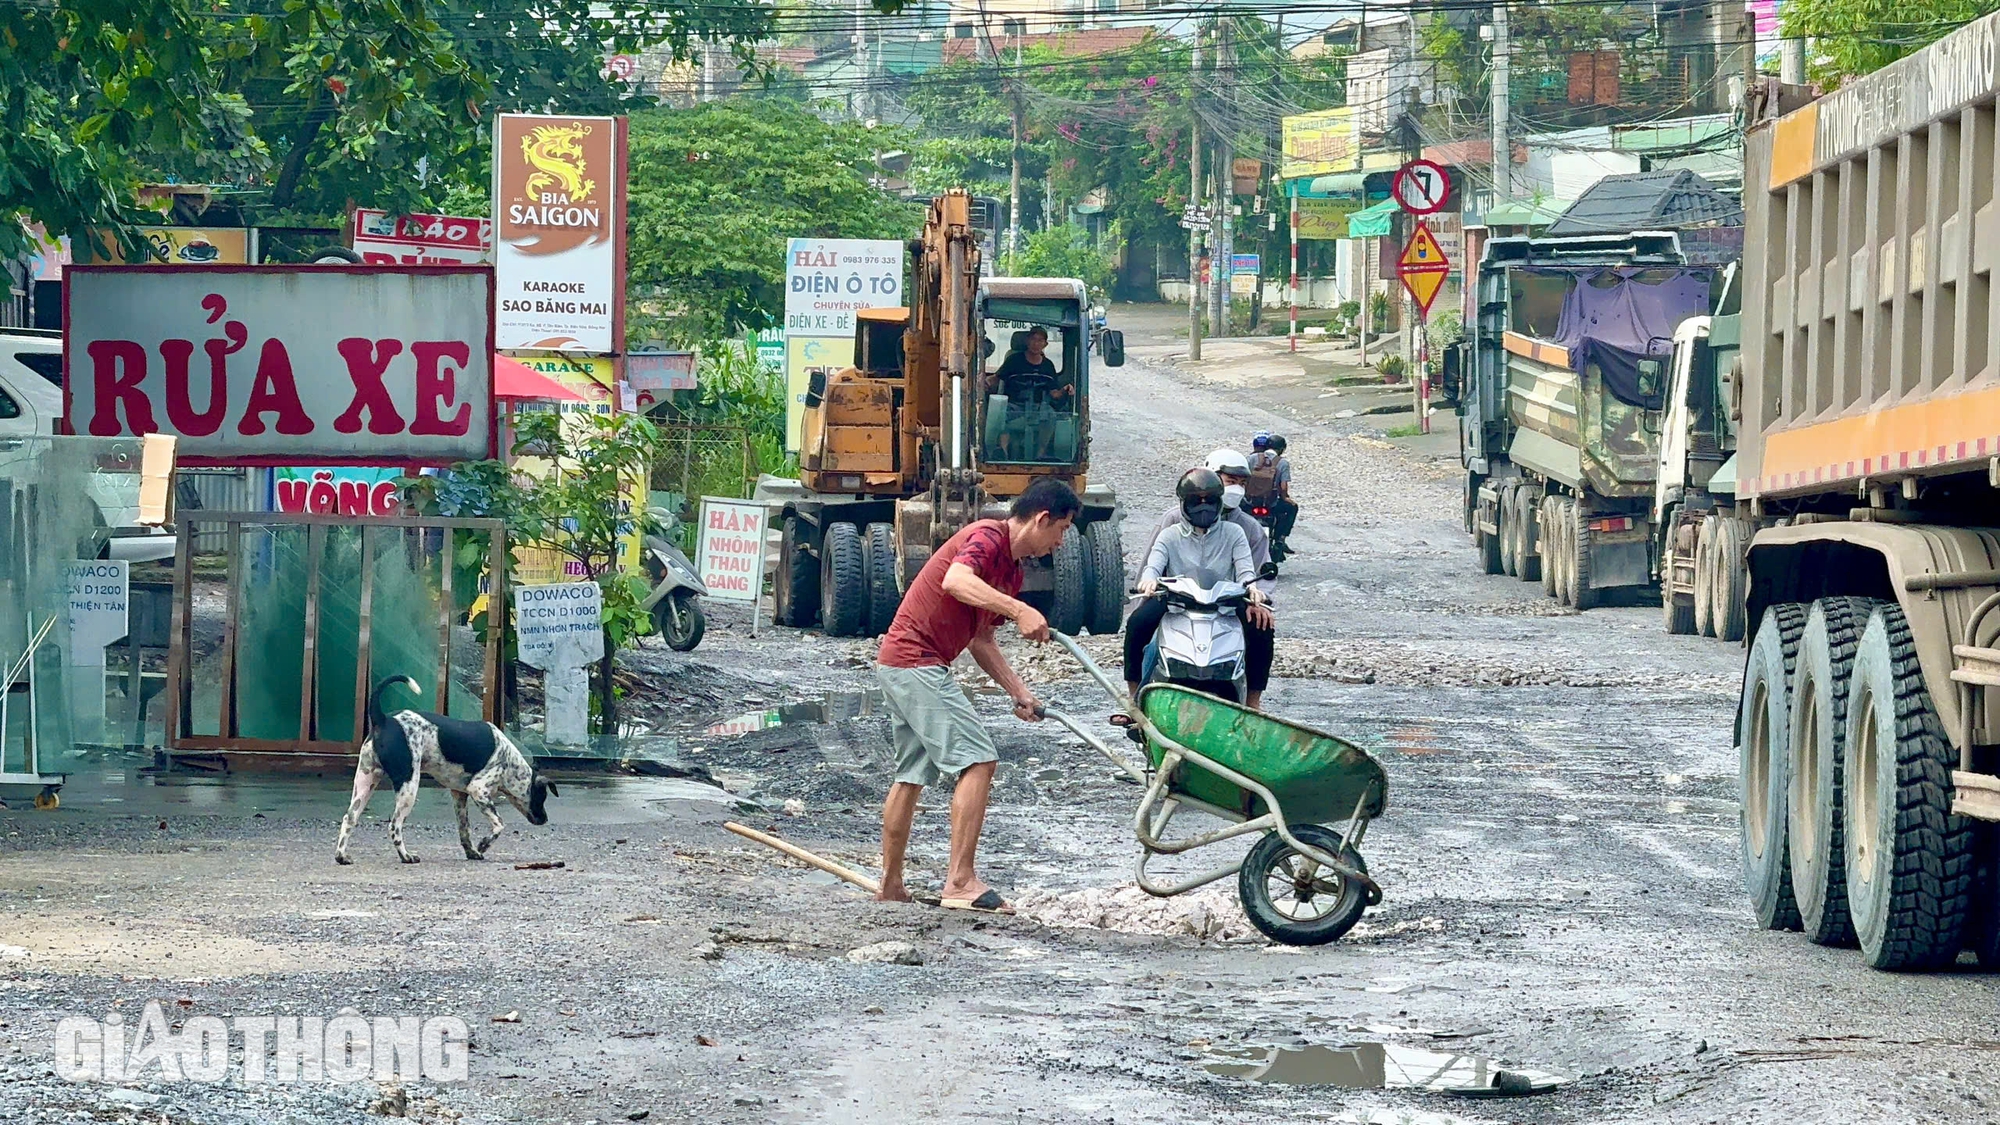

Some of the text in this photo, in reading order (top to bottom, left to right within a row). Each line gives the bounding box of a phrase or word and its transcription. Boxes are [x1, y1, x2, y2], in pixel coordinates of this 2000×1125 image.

[541, 192, 569, 205] BIA
[509, 204, 599, 227] SAIGON
[794, 245, 838, 267] HẢI
[843, 256, 862, 264] 0983
[523, 281, 585, 293] KARAOKE
[791, 271, 897, 298] ĐIỆN Ô TÔ
[502, 298, 607, 315] SAO BĂNG MAI
[813, 301, 850, 310] CHUYÊN
[789, 312, 811, 331] ĐIỆN
[815, 315, 827, 328] XE
[87, 293, 471, 437] RỬA XE
[277, 471, 399, 516] VÕNG
[709, 508, 759, 533] HÀN
[709, 535, 758, 554] NHÔM
[708, 555, 751, 573] THAU
[84, 585, 121, 595] D1200
[705, 573, 748, 591] GANG
[522, 587, 593, 602] DOWACO
[70, 601, 125, 611] THIỆN TÂN
[521, 606, 597, 618] TCCN D1000
